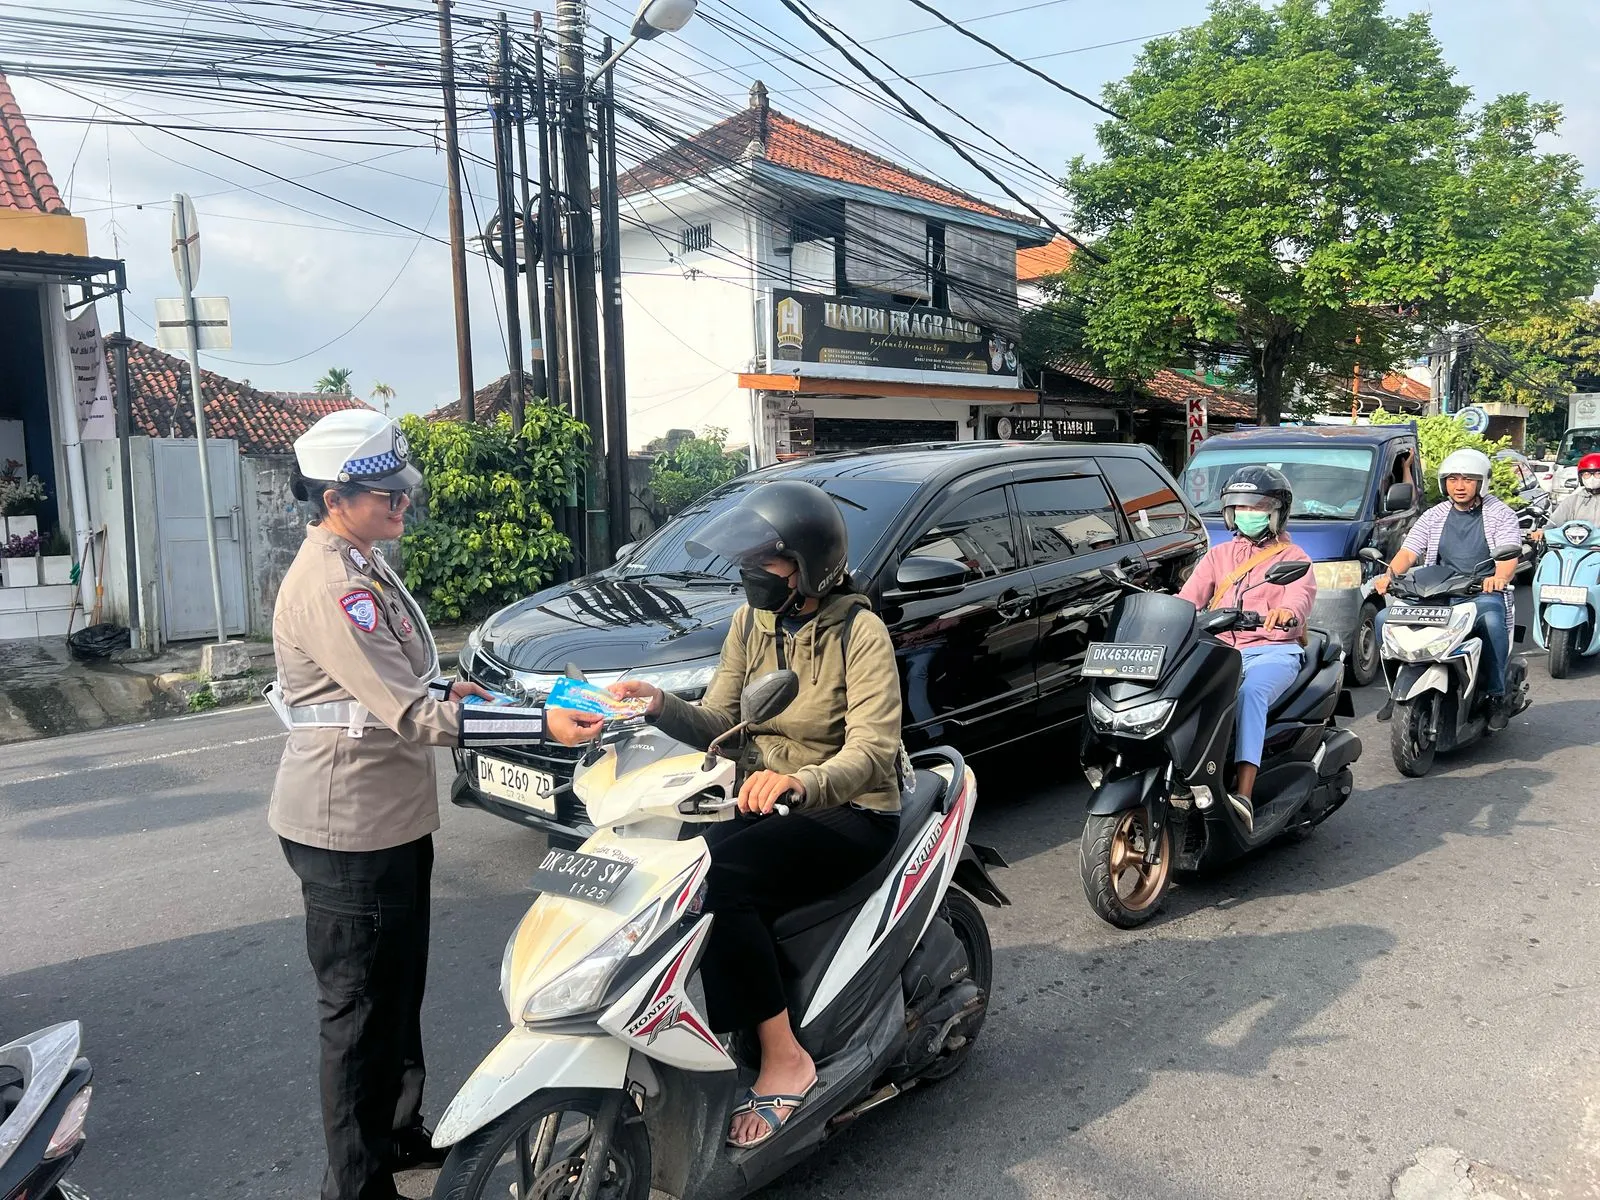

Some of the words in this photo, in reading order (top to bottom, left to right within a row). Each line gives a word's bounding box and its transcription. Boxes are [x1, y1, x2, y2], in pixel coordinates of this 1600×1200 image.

[824, 302, 887, 333] HABIBI
[1056, 420, 1097, 435] TIMBUL
[480, 760, 495, 783] DK
[500, 766, 529, 792] 1269
[538, 851, 562, 873] DK
[558, 855, 596, 879] 3413
[598, 863, 628, 885] SW
[627, 993, 676, 1036] HONDA
